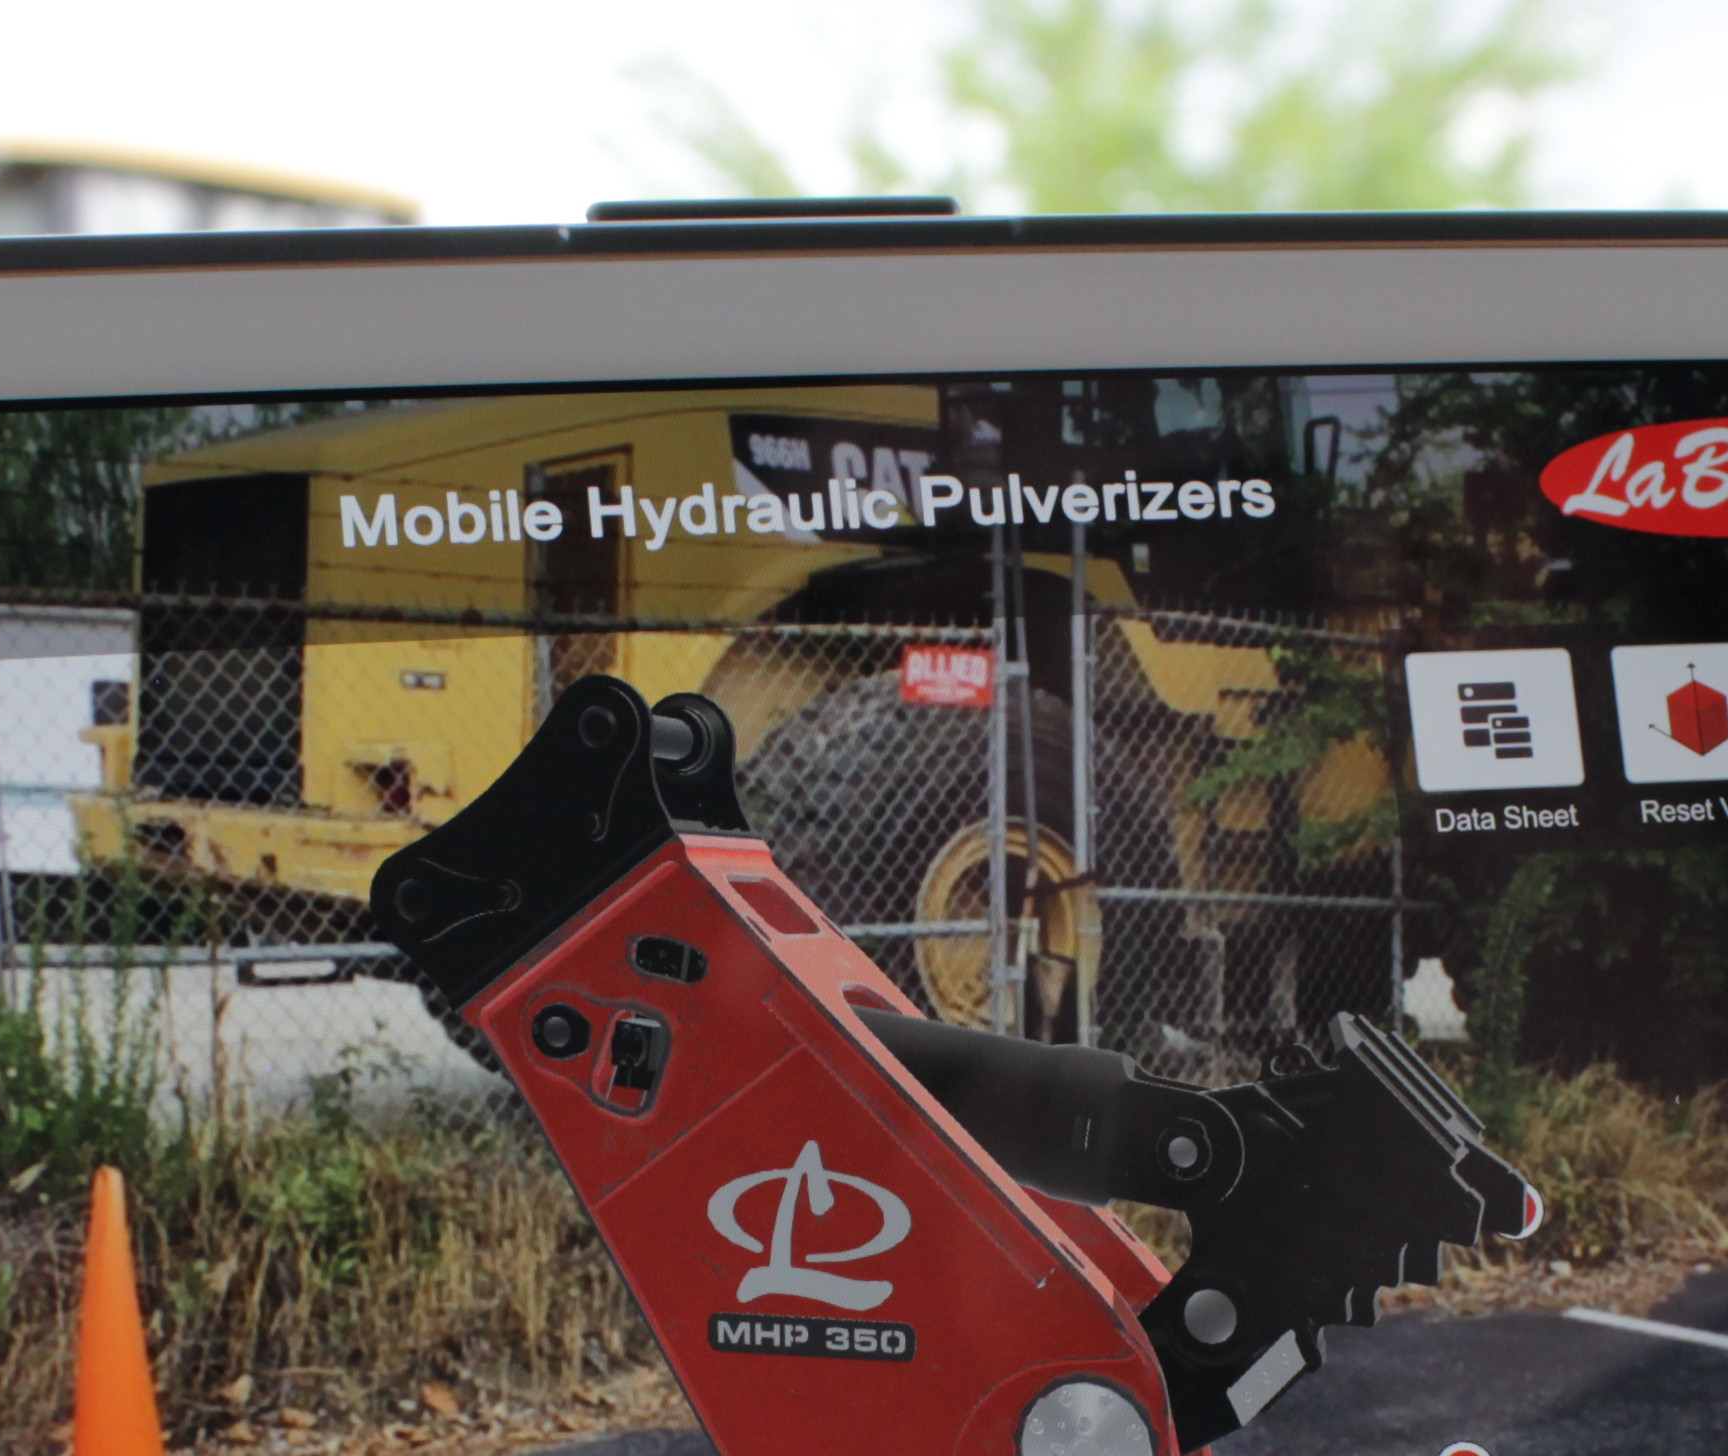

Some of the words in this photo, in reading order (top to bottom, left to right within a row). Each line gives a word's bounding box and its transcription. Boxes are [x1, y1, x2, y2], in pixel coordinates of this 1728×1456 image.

[340, 489, 563, 547] Mobile
[587, 482, 899, 550] Hydraulic
[920, 470, 1276, 527] Pulverizers
[1435, 808, 1496, 832] Data
[1504, 804, 1579, 829] Sheet
[1641, 799, 1714, 823] Reset
[717, 1320, 809, 1347] MHP
[825, 1327, 906, 1354] 350
